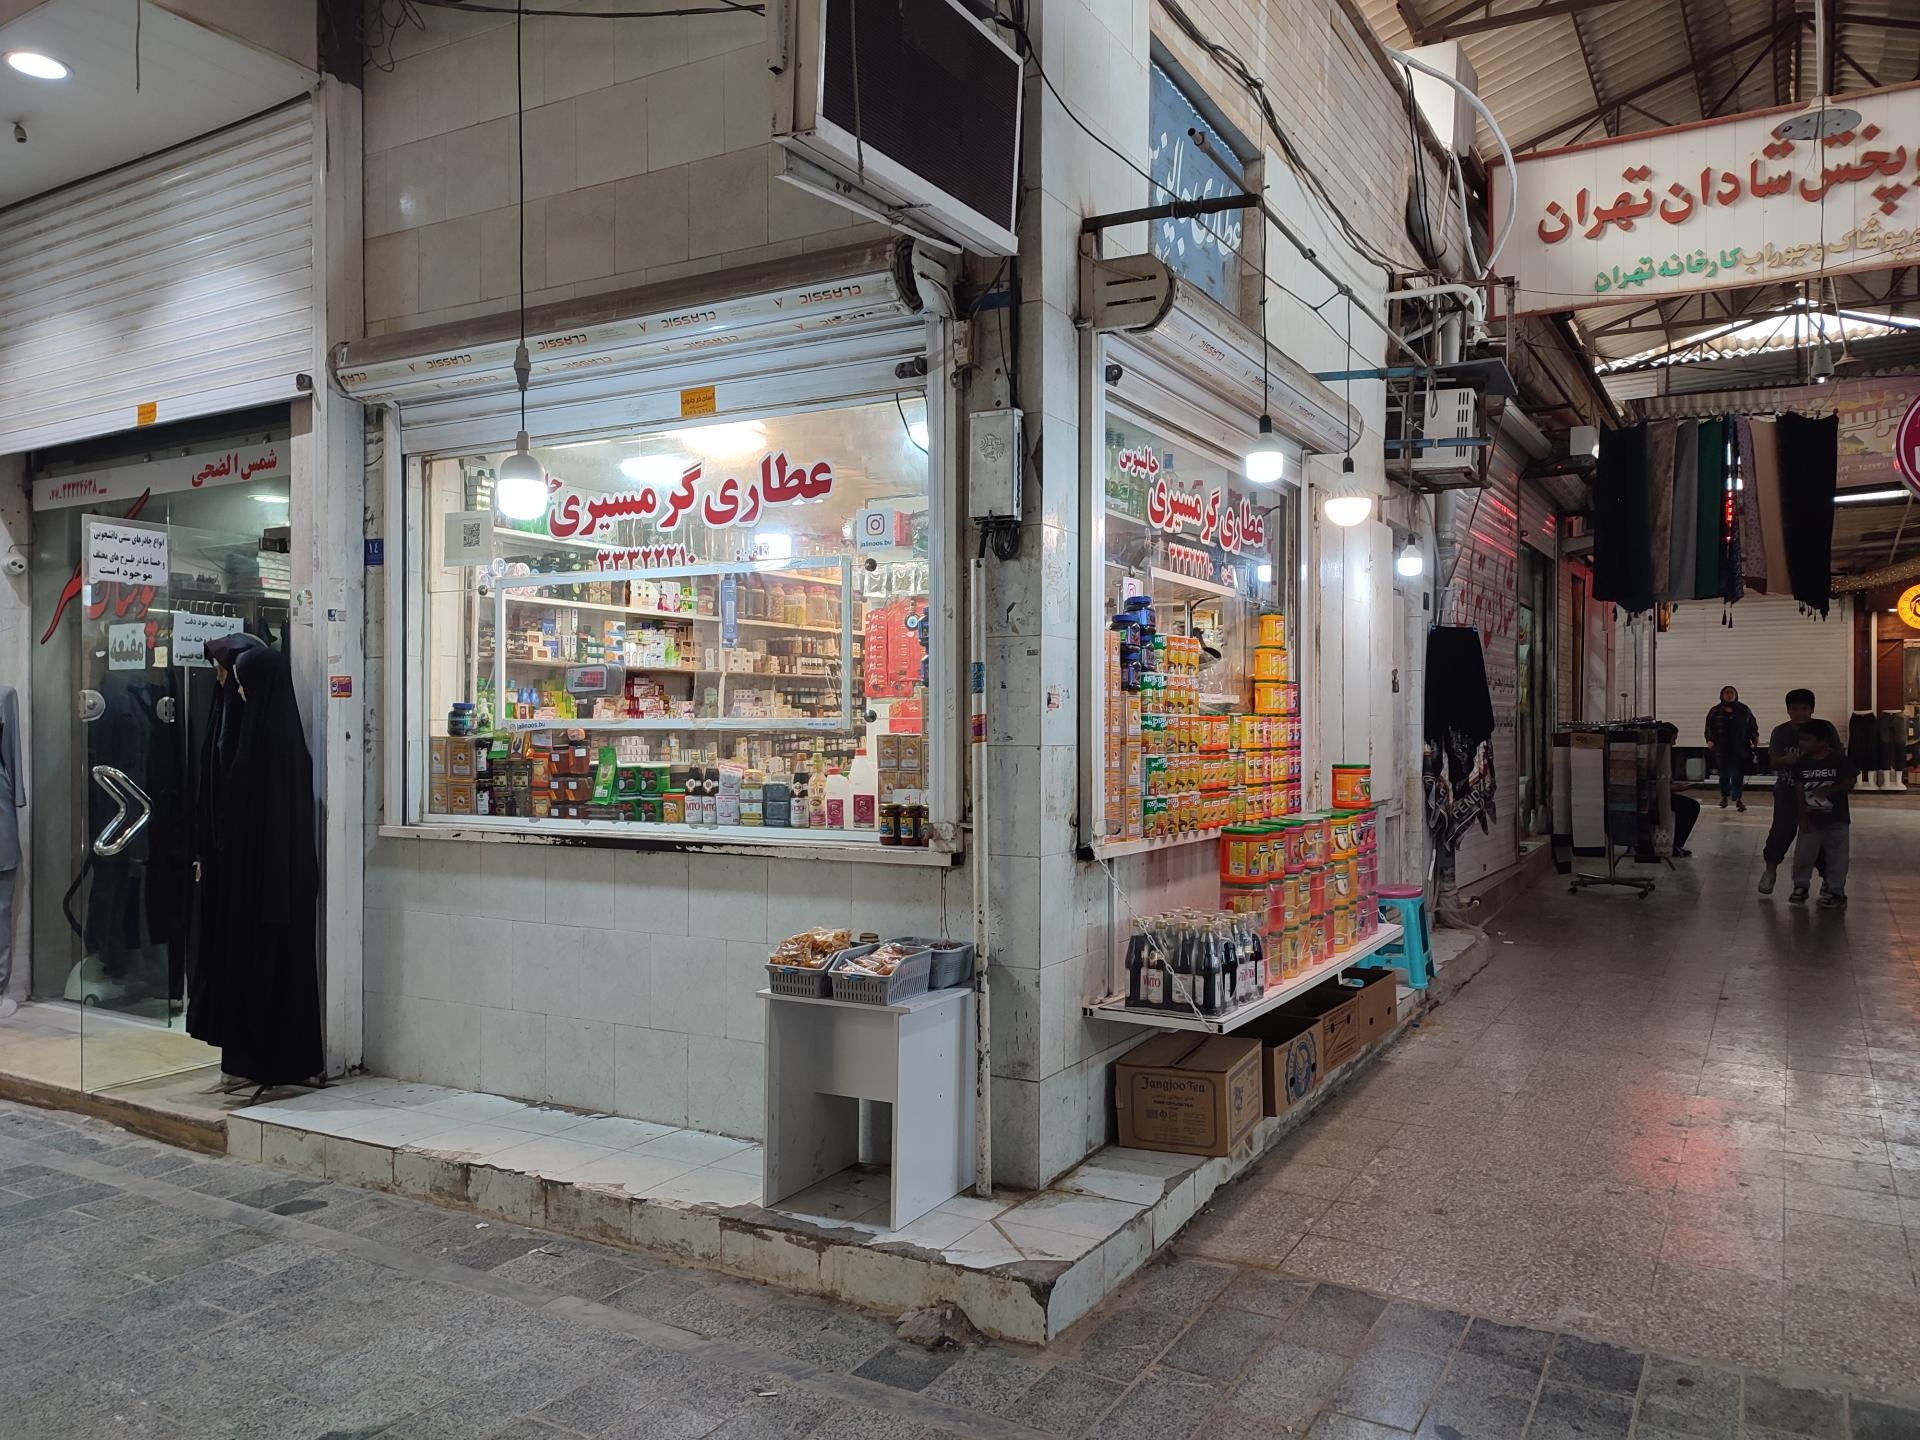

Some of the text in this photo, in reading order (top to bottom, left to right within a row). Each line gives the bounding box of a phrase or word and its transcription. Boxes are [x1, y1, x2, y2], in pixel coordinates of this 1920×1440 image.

[1538, 164, 1653, 244] تهران
[1594, 256, 1655, 292] تهران
[1658, 247, 1741, 278] کارخانه
[799, 284, 862, 305] CLASSIC
[661, 310, 717, 329] CLASSIC
[537, 333, 588, 351] CLASSIC
[426, 354, 472, 369] CLASSIC
[240, 448, 278, 481] شمس
[703, 452, 833, 525] عطاری
[1220, 499, 1264, 551] عطاری
[153, 538, 165, 549] انواع
[99, 566, 120, 576] است
